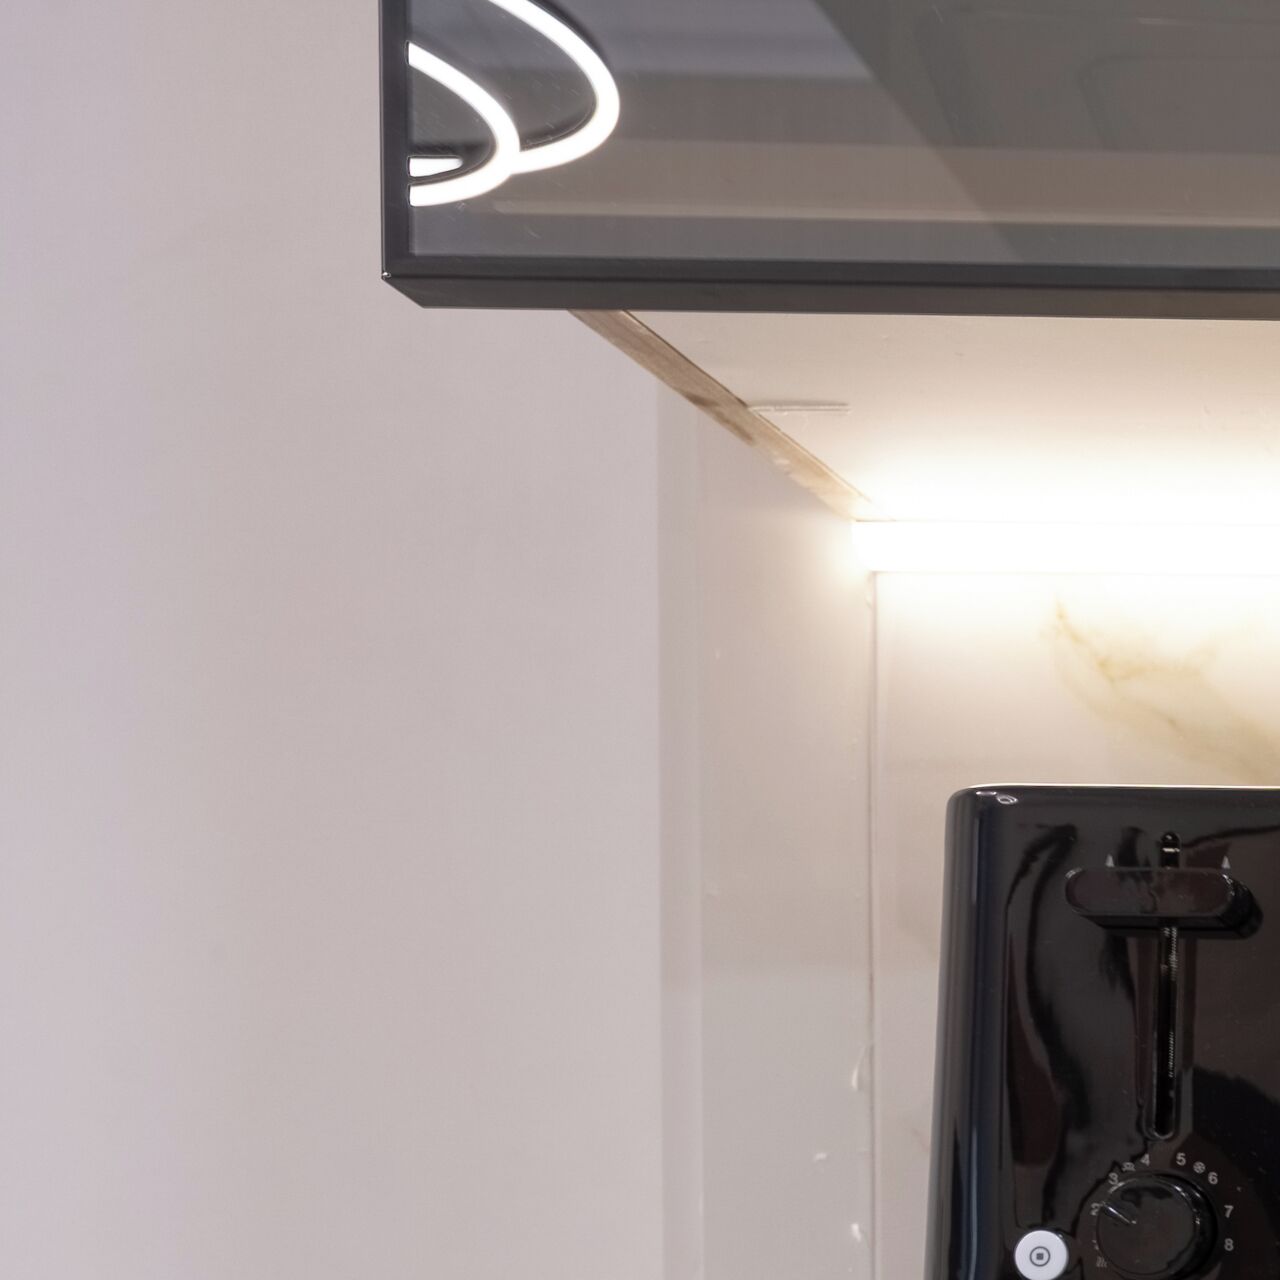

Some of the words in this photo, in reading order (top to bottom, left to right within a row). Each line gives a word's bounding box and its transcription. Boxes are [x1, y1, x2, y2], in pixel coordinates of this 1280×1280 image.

[1140, 1153, 1150, 1166] 4
[1176, 1152, 1186, 1166] 5
[1108, 1172, 1119, 1185] 3
[1208, 1172, 1218, 1184] 6
[1224, 1205, 1233, 1218] 7
[1224, 1238, 1233, 1251] 8
